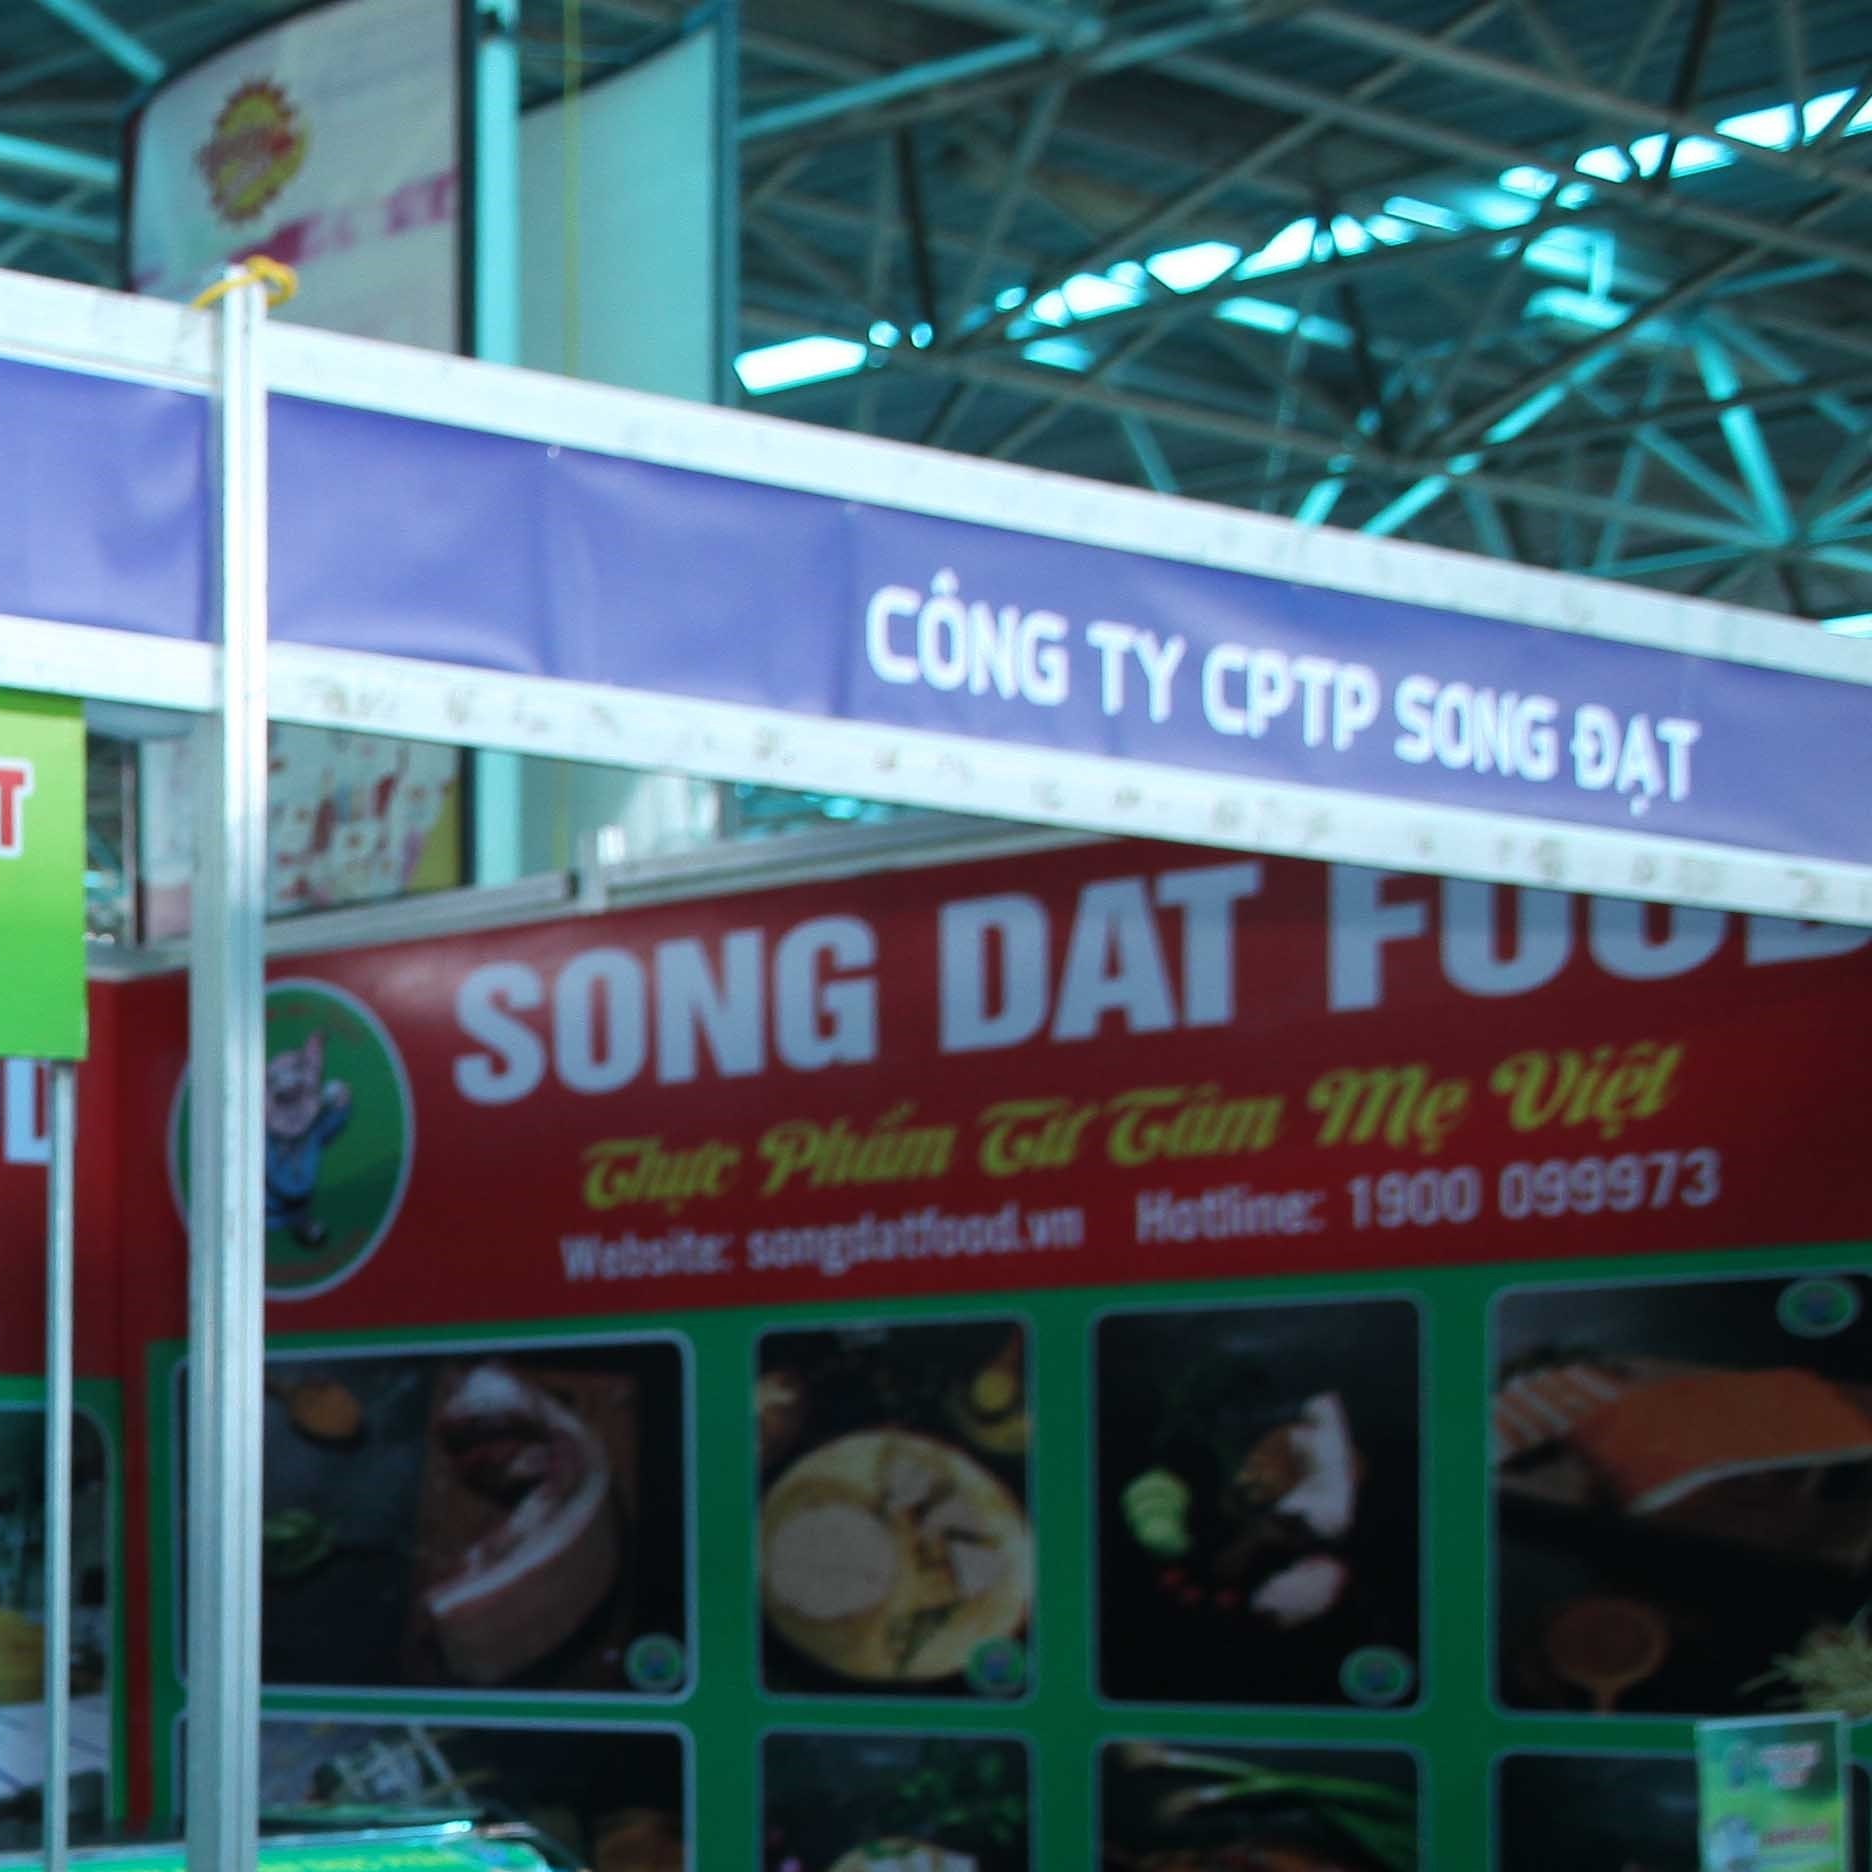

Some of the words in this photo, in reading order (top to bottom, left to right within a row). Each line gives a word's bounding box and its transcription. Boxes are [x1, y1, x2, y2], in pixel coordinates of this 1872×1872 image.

[866, 568, 1067, 706] CÔNG
[1087, 622, 1187, 723] TY
[1203, 646, 1378, 749] CPTP
[1394, 674, 1558, 779] SONG
[1571, 705, 1701, 814] ĐẠT
[453, 915, 879, 1106] SONG
[937, 863, 1262, 1054] DAT
[1327, 864, 1872, 1013] FOO
[746, 1206, 1083, 1277] songdatfood.vn
[1348, 1166, 1480, 1228] 1900
[1499, 1148, 1720, 1219] 099973
